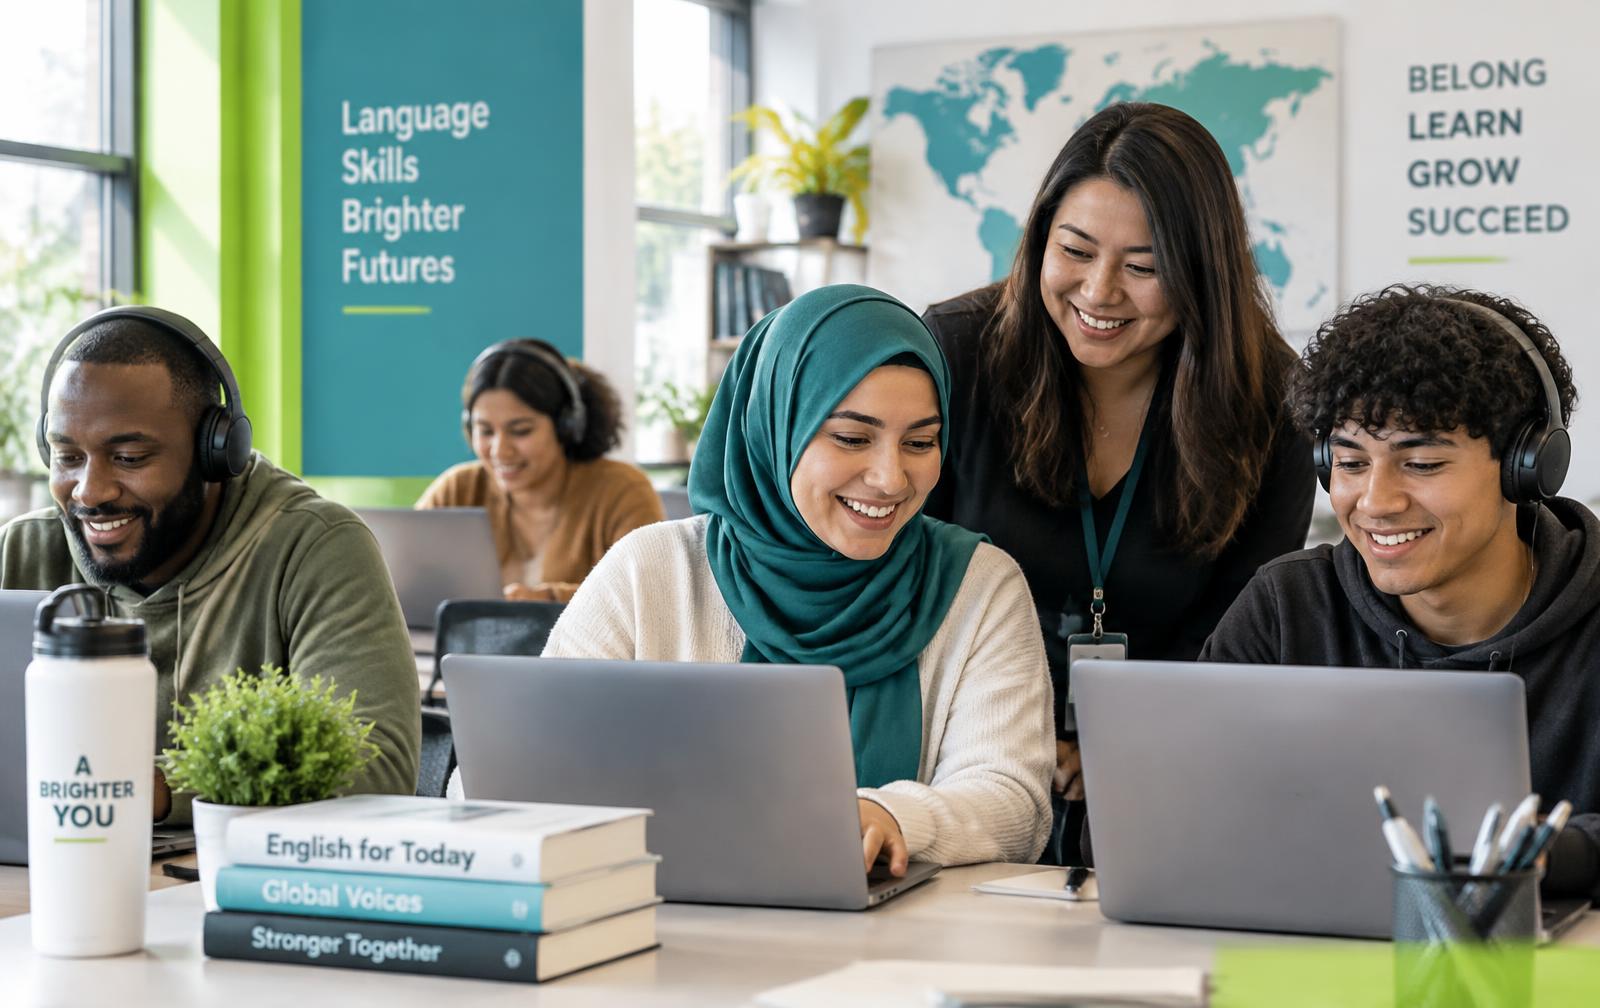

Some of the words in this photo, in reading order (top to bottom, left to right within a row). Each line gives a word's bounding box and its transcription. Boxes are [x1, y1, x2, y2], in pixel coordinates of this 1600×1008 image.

[1408, 58, 1547, 93] BELONG
[342, 100, 490, 142] Language
[1408, 108, 1522, 140] LEARN
[341, 146, 419, 185] Skills
[1407, 157, 1520, 188] GROW
[342, 195, 465, 242] Brighter
[1407, 204, 1570, 236] SUCCEED
[342, 248, 455, 284] Futures
[75, 755, 92, 775] A
[40, 781, 134, 799] BRIGHTER
[53, 804, 114, 828] YOU
[266, 834, 351, 863] English
[359, 840, 394, 862] for
[401, 841, 476, 869] Today
[262, 879, 339, 905] Global
[346, 887, 423, 913] Voices
[252, 926, 341, 958] Stronger
[346, 933, 442, 963] Together
